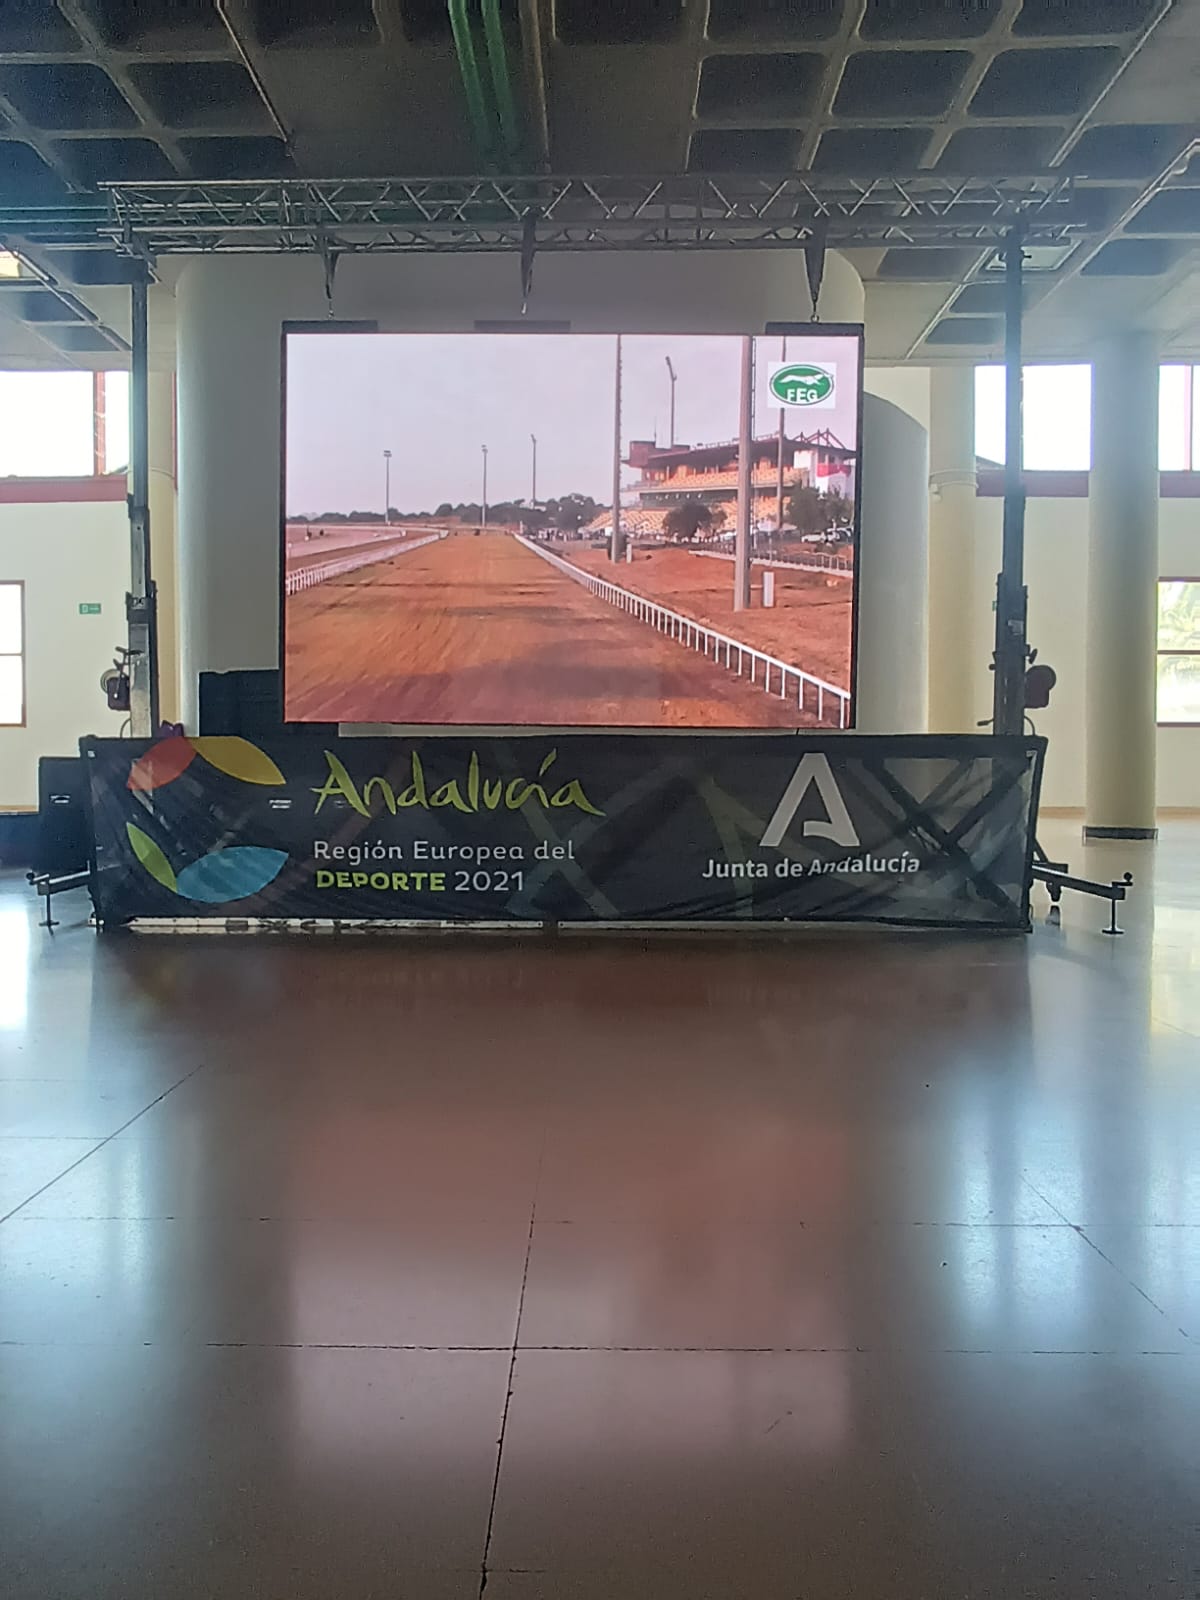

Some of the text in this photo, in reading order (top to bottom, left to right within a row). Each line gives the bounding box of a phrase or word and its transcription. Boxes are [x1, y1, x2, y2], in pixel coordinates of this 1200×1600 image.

[786, 388, 818, 402] FEG
[310, 748, 606, 818] Andalucía
[314, 840, 575, 865] Región Europea del
[702, 851, 920, 878] Junta de Andalucía
[316, 870, 523, 891] DEPORTE 2021
